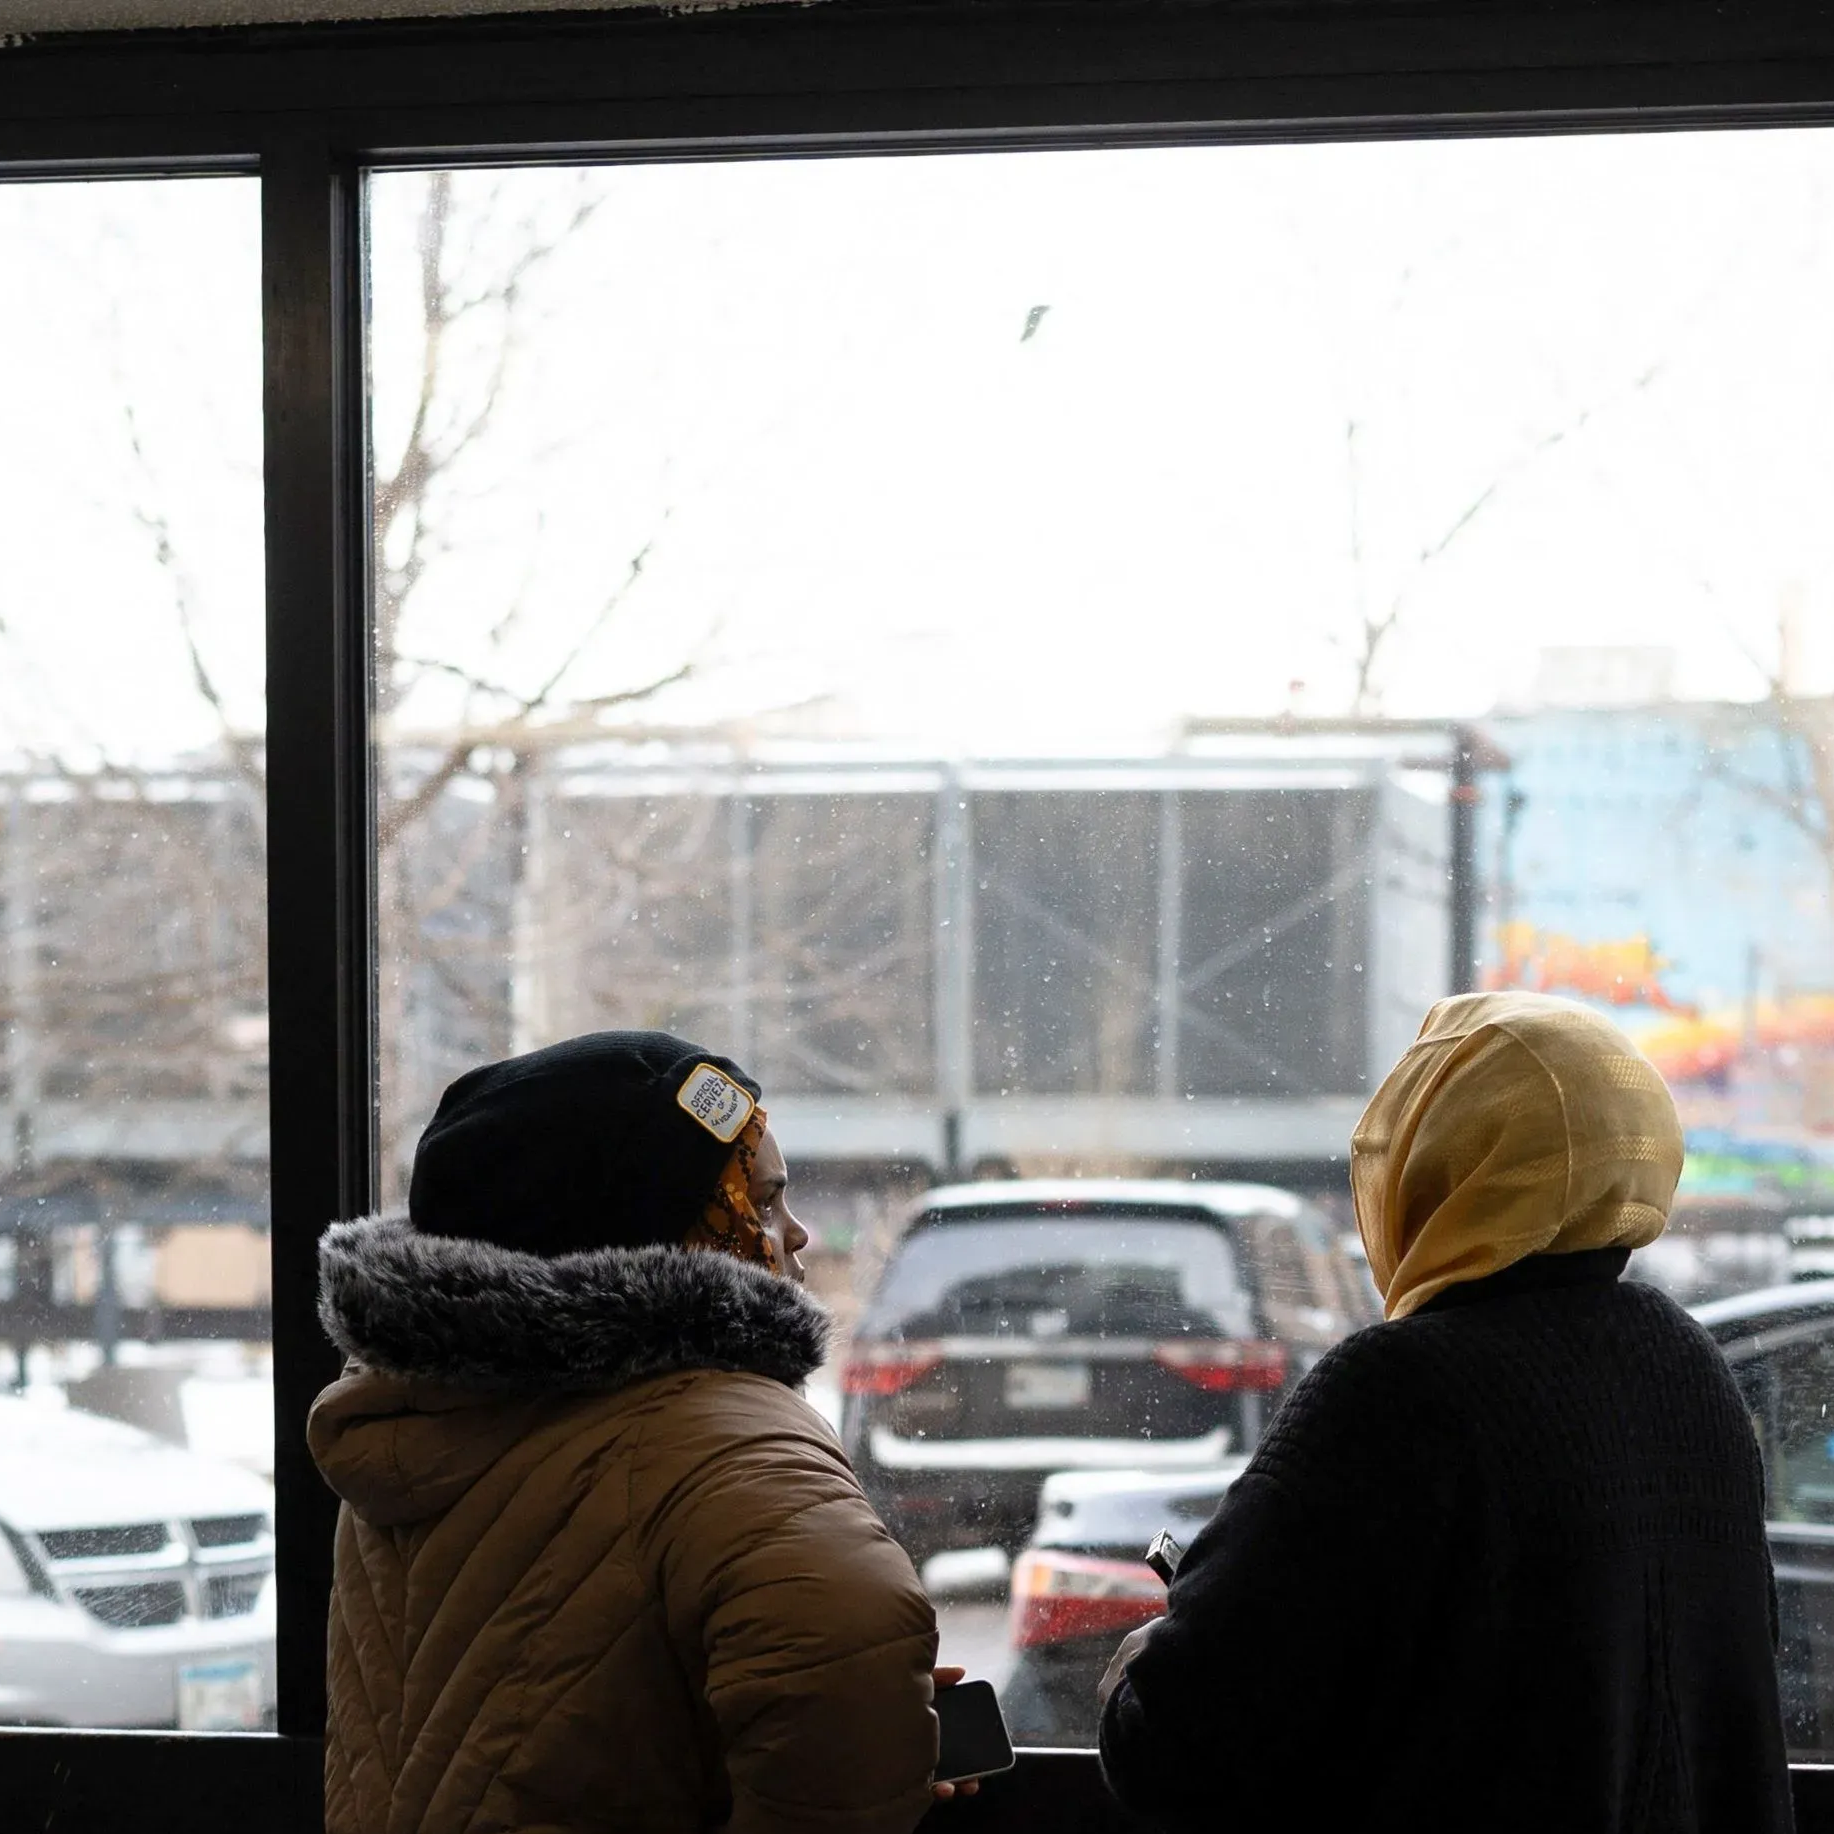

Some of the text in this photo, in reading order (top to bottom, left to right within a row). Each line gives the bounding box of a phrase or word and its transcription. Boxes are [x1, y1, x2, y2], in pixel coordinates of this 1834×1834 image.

[691, 1075, 719, 1107] OFFICIAL
[697, 1078, 728, 1119] CERVEZA
[717, 1100, 725, 1110] OF
